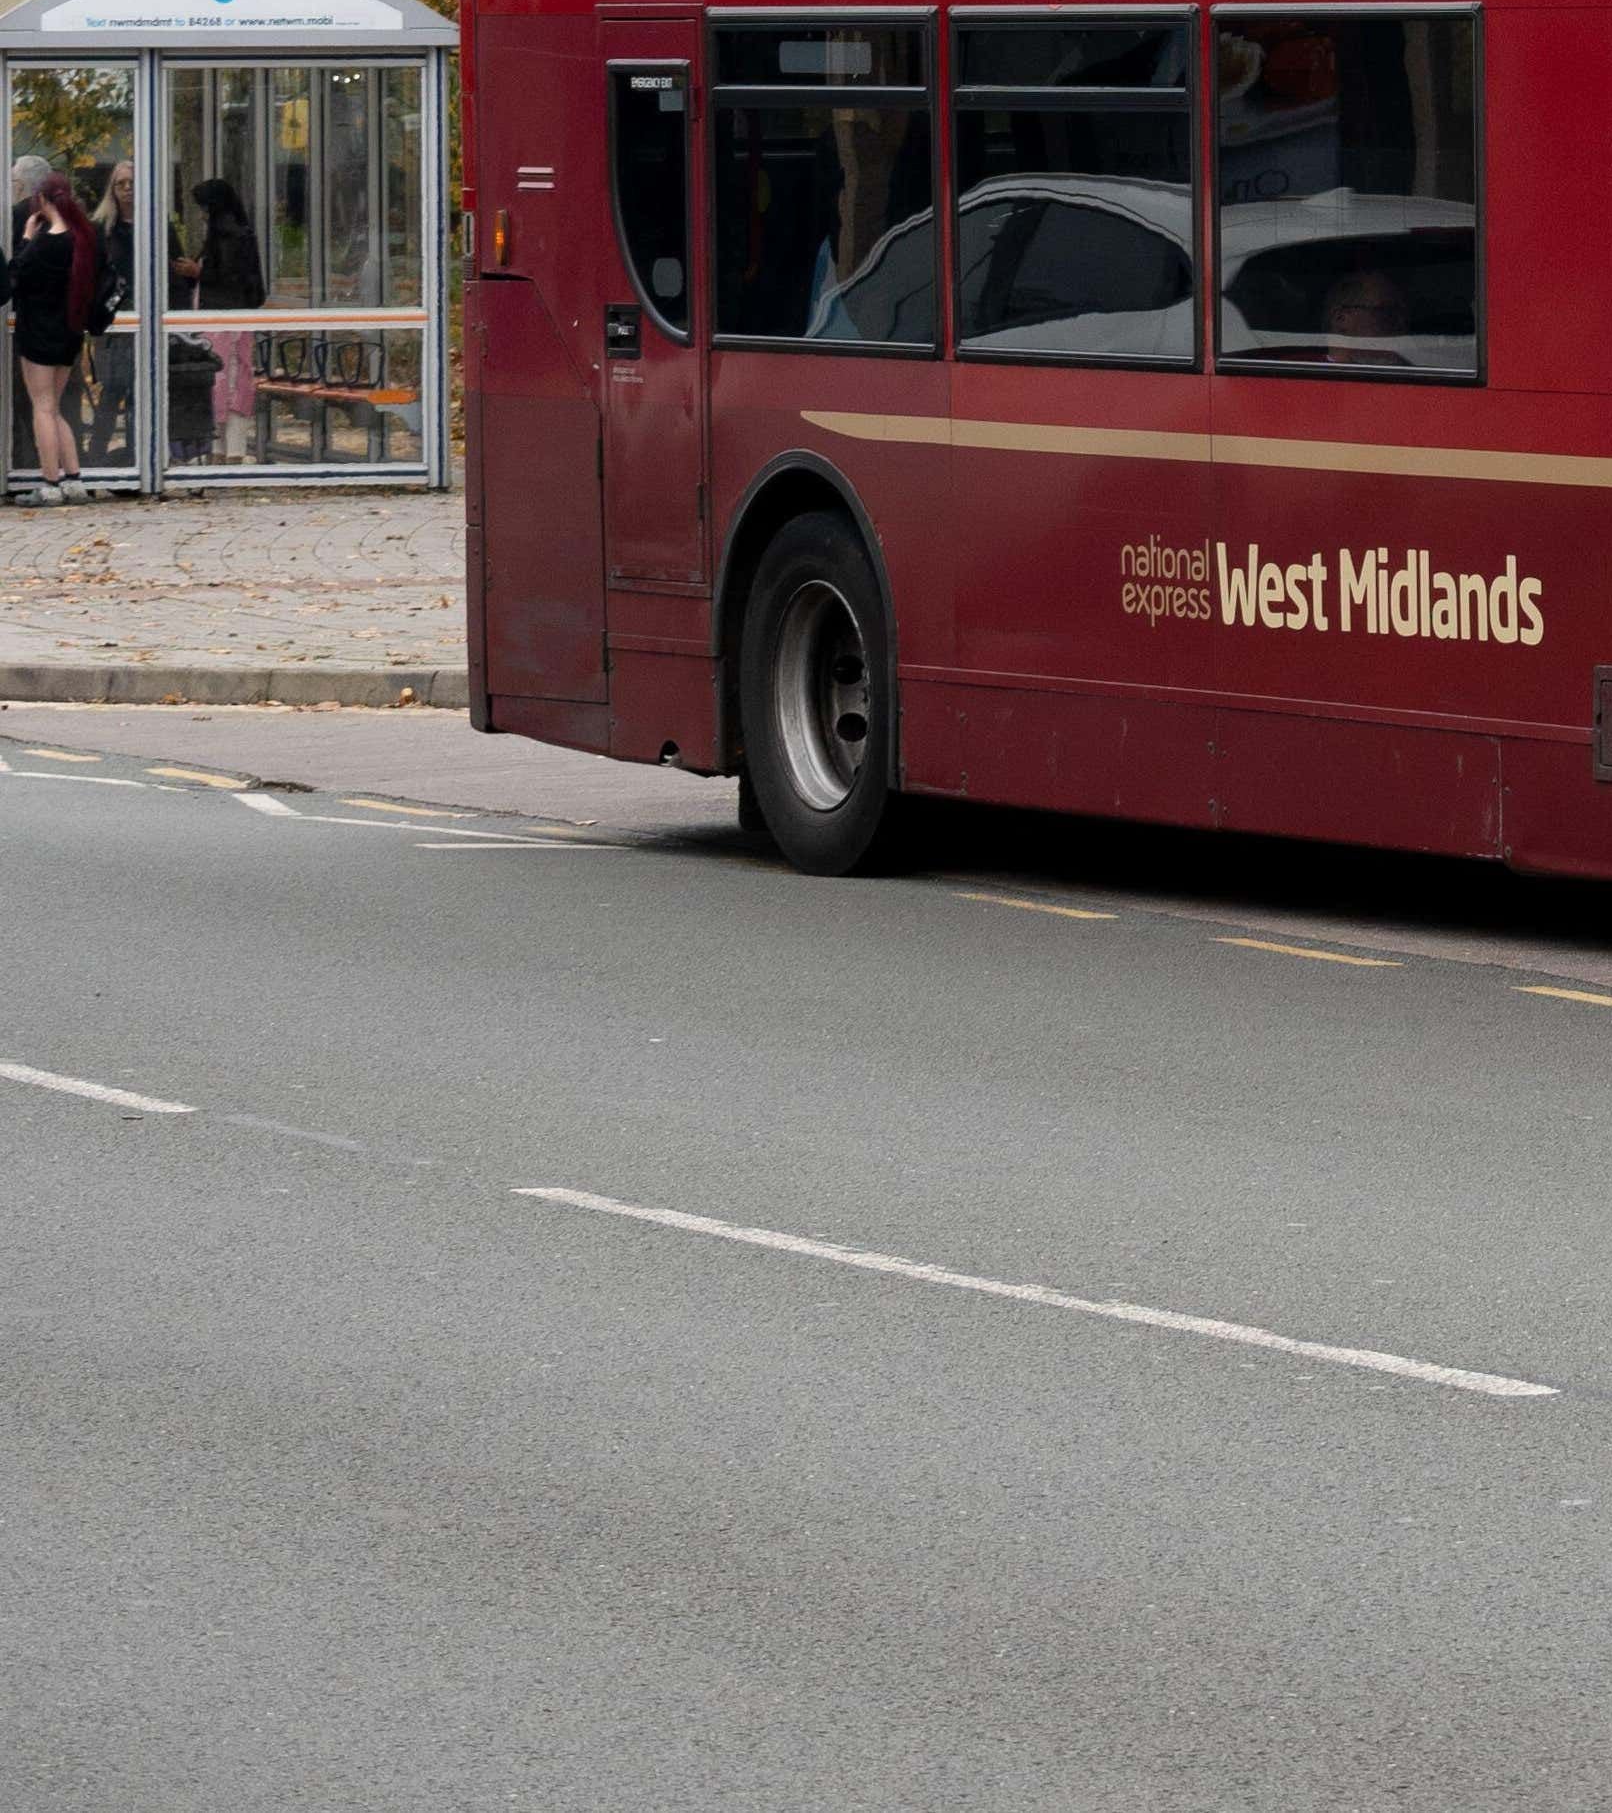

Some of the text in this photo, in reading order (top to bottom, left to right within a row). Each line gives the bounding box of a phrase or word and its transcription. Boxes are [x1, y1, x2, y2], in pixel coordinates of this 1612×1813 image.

[1121, 535, 1544, 646] national West Midlands
[1122, 581, 1211, 627] express
